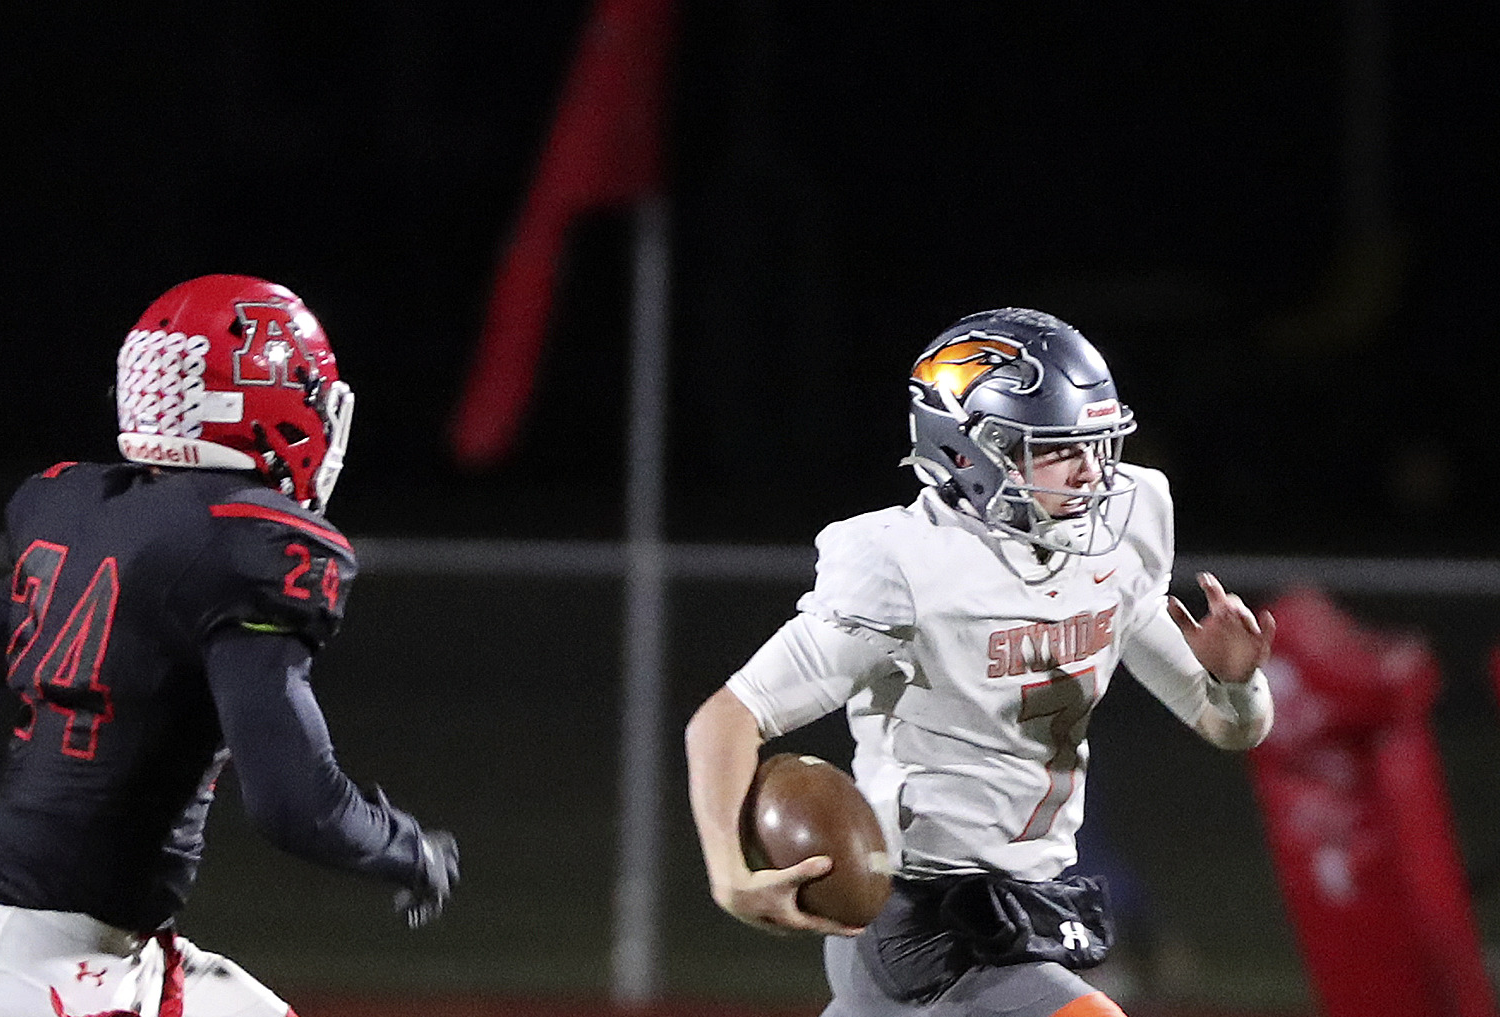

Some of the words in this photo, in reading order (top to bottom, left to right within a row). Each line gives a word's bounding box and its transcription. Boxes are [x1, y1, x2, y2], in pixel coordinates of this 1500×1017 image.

[232, 301, 316, 389] A
[283, 543, 341, 610] 24
[6, 539, 120, 761] 24
[1008, 666, 1099, 842] 7
